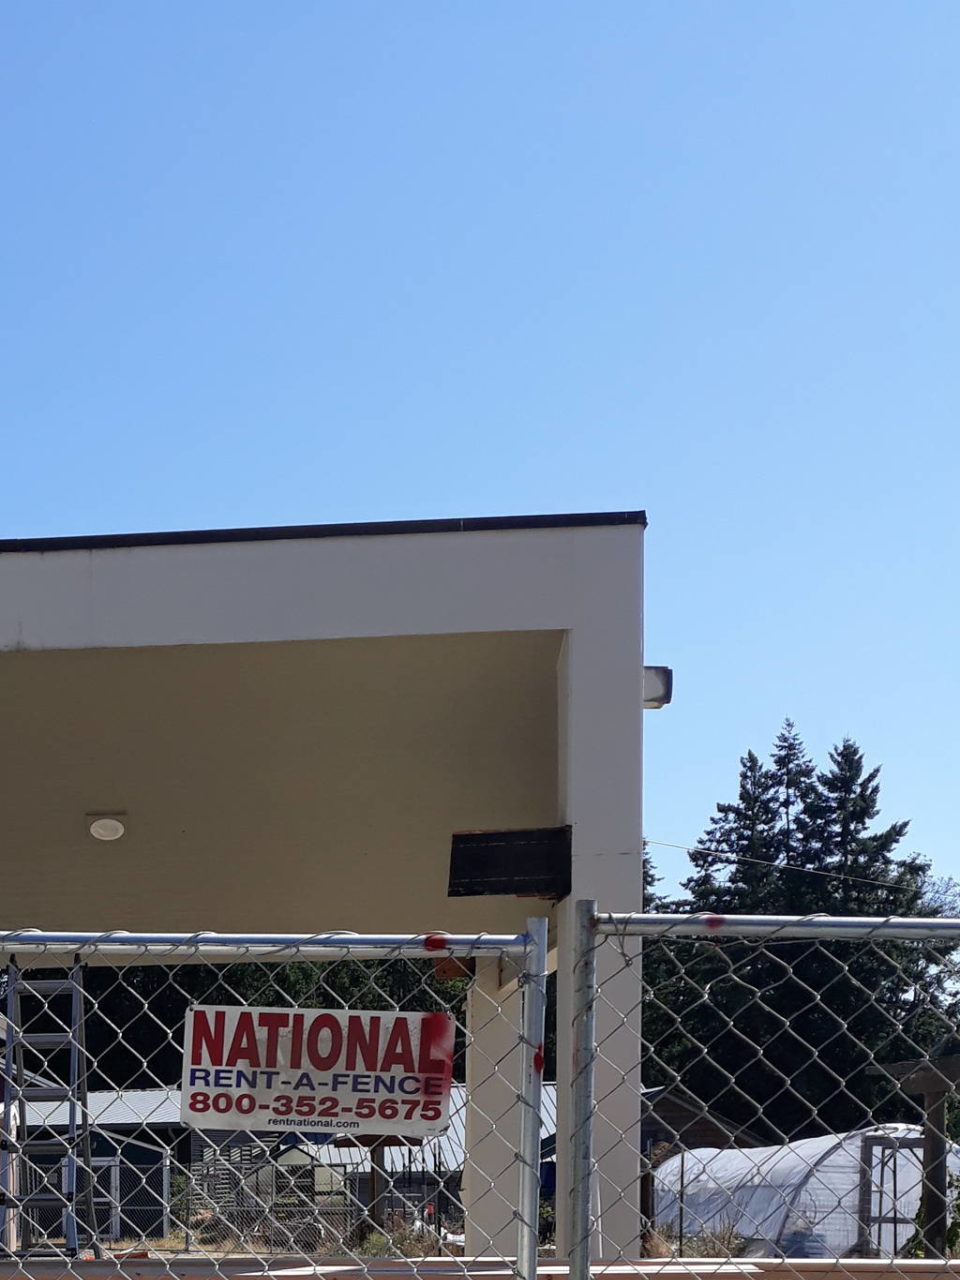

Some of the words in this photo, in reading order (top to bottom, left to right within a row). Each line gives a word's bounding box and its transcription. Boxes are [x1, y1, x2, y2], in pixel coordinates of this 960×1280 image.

[191, 1010, 446, 1074] NATIONAL
[189, 1069, 444, 1096] RENT-A-FENCE
[189, 1091, 442, 1121] 800-352-5675
[267, 1116, 360, 1129] rentnational.com
